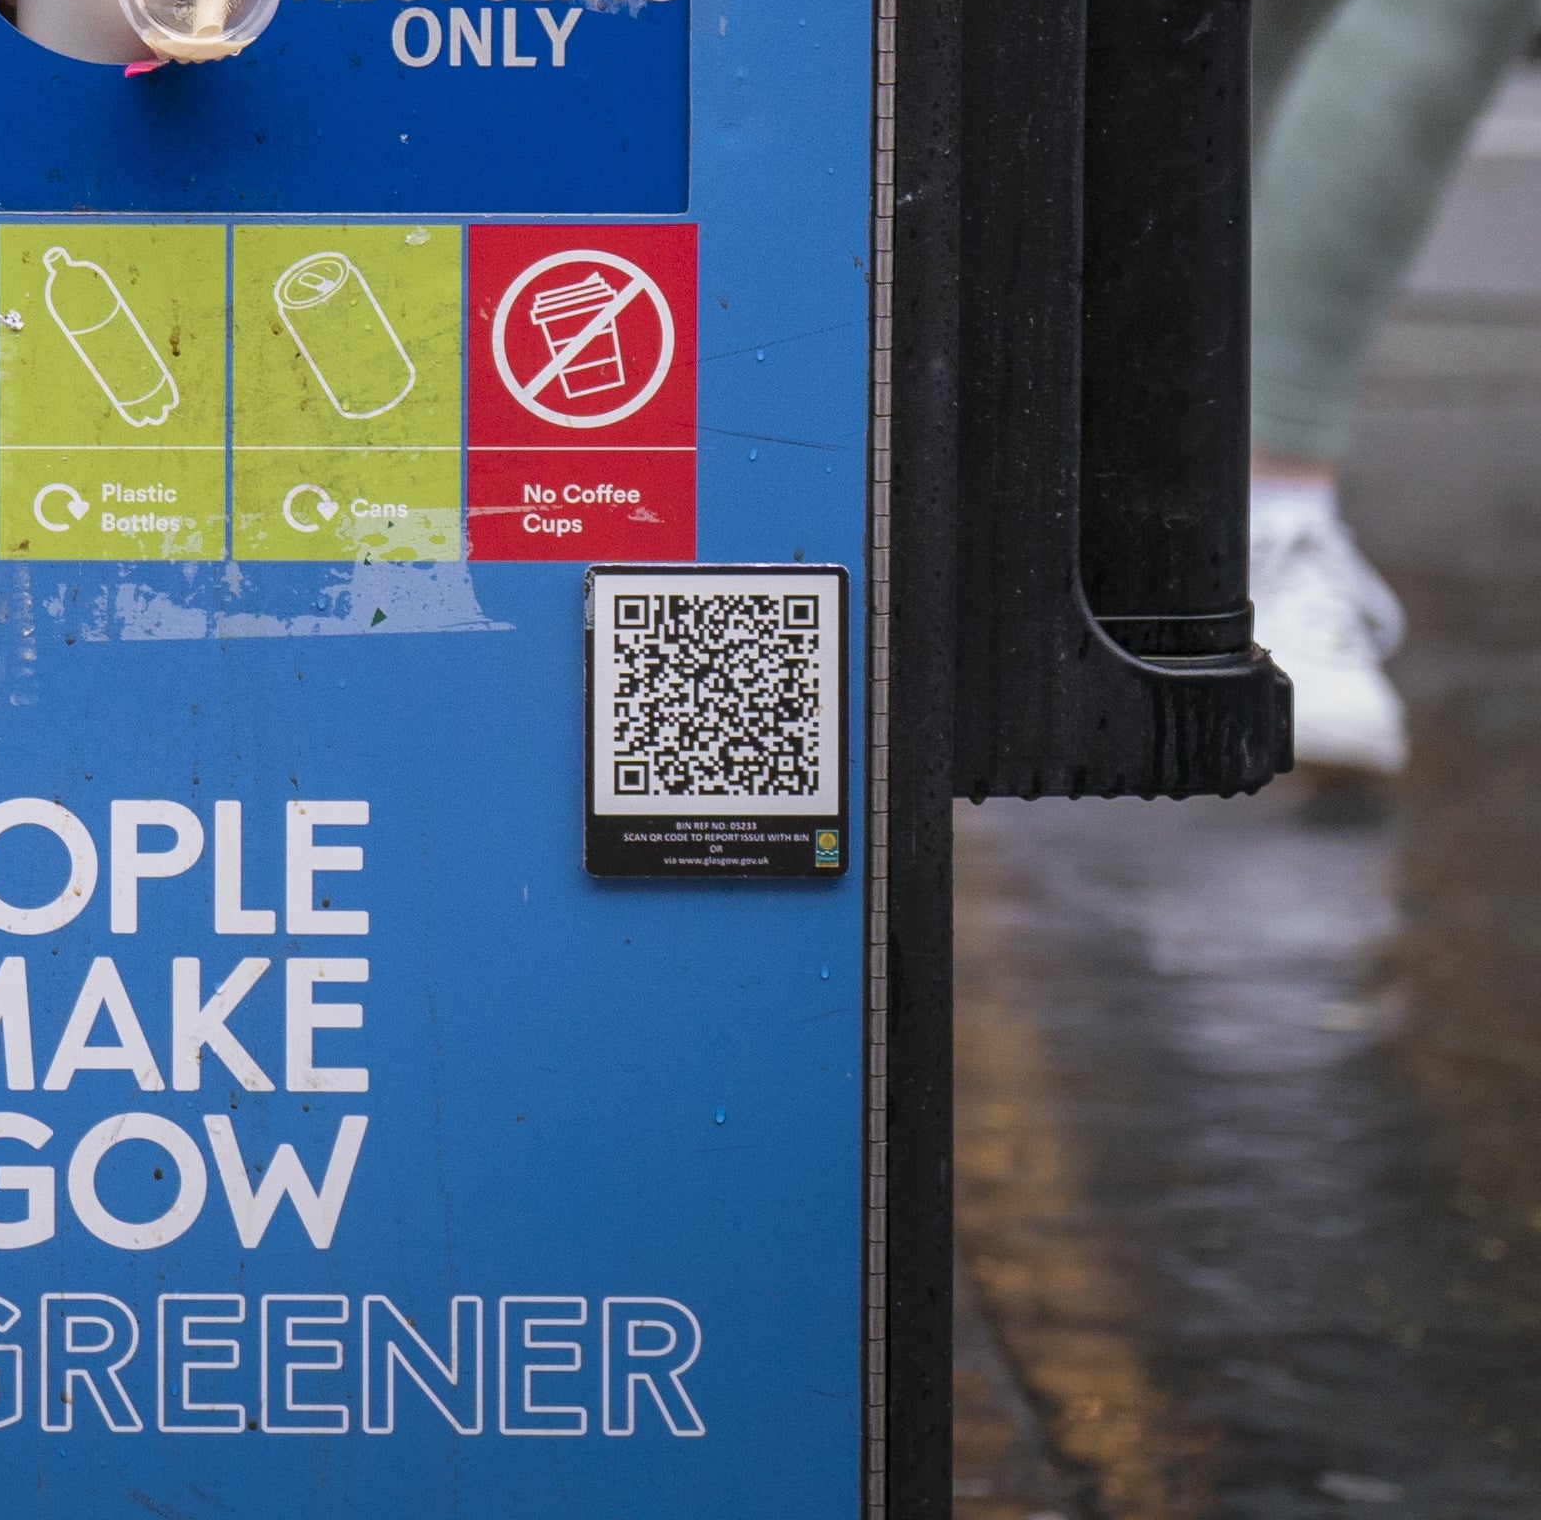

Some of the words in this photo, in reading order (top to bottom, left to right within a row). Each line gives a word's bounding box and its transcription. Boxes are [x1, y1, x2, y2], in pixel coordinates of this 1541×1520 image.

[392, 7, 583, 68] ONLY
[101, 482, 177, 503] Plastic
[523, 484, 557, 504] No
[562, 483, 640, 504] Coffee
[350, 498, 409, 518] Cans
[101, 512, 180, 532] Bottles
[522, 513, 583, 537] Cups
[675, 821, 692, 830] BIN
[693, 821, 710, 830] REF
[623, 833, 647, 842] SCAN
[649, 833, 663, 842] QR
[664, 833, 689, 842] CODE
[690, 833, 703, 842] TO
[704, 833, 738, 842] REPORT
[740, 833, 765, 842] ISSUE
[767, 833, 792, 842] WITH
[793, 833, 810, 842] BIN
[709, 845, 723, 854] OR
[663, 857, 677, 867] via
[678, 857, 769, 867] www.glasgow.gov.uk
